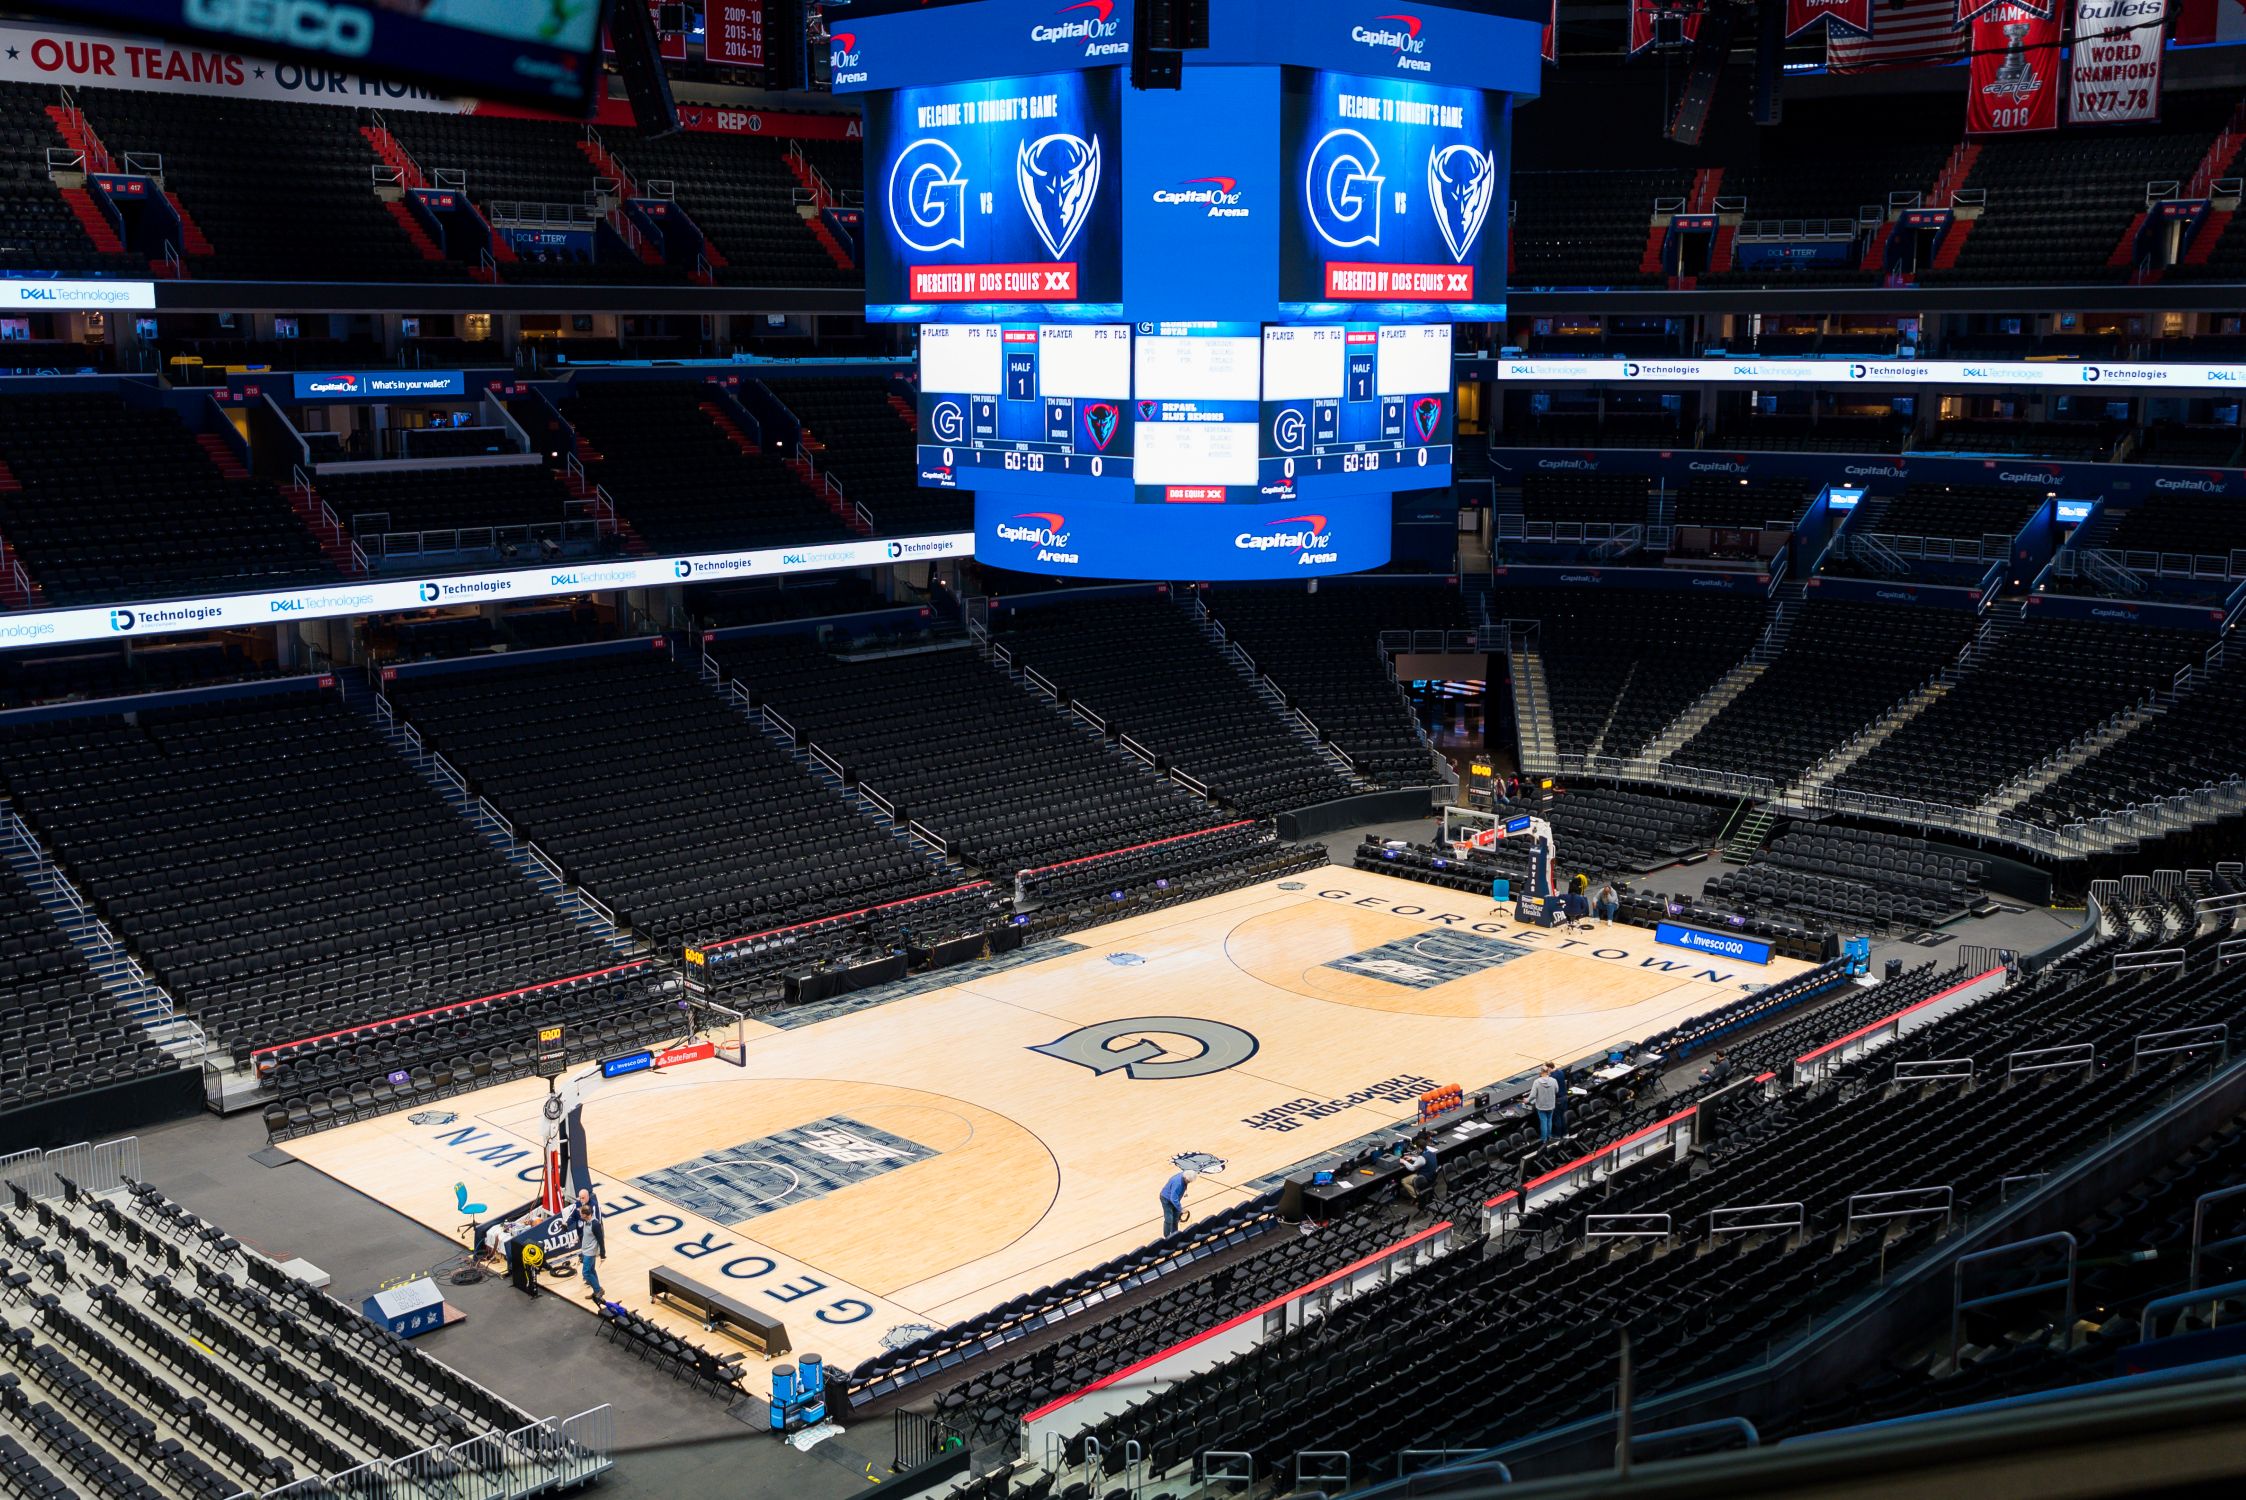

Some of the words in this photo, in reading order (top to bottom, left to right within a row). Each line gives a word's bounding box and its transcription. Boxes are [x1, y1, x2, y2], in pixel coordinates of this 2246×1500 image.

[724, 7, 762, 24] 2009-10
[2079, 1, 2162, 19] bullets
[725, 25, 762, 41] 2015-16
[2103, 27, 2132, 42] NBA
[725, 42, 762, 58] 2016-17
[1085, 42, 1129, 57] Arena
[2092, 45, 2141, 62] WORLD
[31, 39, 117, 76] OUR
[125, 46, 245, 87] TEAMS
[1397, 55, 1431, 72] Arena
[275, 62, 348, 94] OUR
[835, 72, 868, 84] Arena
[2075, 62, 2156, 82] CHAMPIONS
[2078, 90, 2148, 112] 1977-78
[918, 103, 961, 128] WELCOME
[964, 102, 975, 124] TO
[977, 97, 1027, 123] TONIGHT'S
[1030, 94, 1058, 119] GAME
[1338, 94, 1381, 120] WELCOME
[1383, 99, 1393, 121] TO
[1395, 101, 1439, 126] TONIGHT'S
[1440, 106, 1463, 129] GAME
[1992, 107, 2029, 128] 2018
[979, 192, 993, 215] VS
[1394, 192, 1407, 214] VS
[1208, 206, 1249, 217] Arena
[917, 272, 962, 293] PRESENTED
[964, 272, 975, 292] BY
[979, 272, 1002, 291] DOS
[1005, 272, 1040, 292] EQUIS
[1044, 272, 1071, 291] XX
[1332, 270, 1377, 291] PRESENTED
[1377, 272, 1388, 291] BY
[1392, 273, 1412, 291] DOS
[1414, 274, 1443, 292] EQUIS
[1446, 274, 1468, 292] XX
[20, 288, 57, 300] DELL
[57, 288, 130, 302] Technologies
[928, 329, 949, 337] PLAYER
[968, 329, 980, 337] PTS
[1048, 329, 1073, 338] PLAYER
[1094, 330, 1108, 339] PTS
[1114, 330, 1127, 339] FLS
[1273, 331, 1294, 340] PLAYER
[1314, 331, 1324, 340] PTS
[1011, 362, 1031, 372] HALF
[1352, 363, 1370, 373] HALF
[1642, 365, 1700, 375] Technologies
[1869, 366, 1929, 377] Technologies
[2103, 369, 2167, 381] Technologies
[371, 380, 398, 390] What's
[406, 381, 422, 391] your
[1018, 378, 1025, 395] 1
[1358, 379, 1365, 396] 1
[982, 405, 990, 417] 0
[1054, 408, 1062, 421] 0
[1324, 409, 1332, 422] 0
[1389, 405, 1396, 418] 0
[943, 447, 954, 467] 0
[976, 451, 981, 463] 1
[1004, 452, 1044, 471] 60:00
[1064, 457, 1069, 469] 1
[1317, 458, 1321, 470] 1
[1343, 452, 1379, 472] 60:00
[1396, 451, 1400, 463] 1
[1417, 447, 1428, 467] 0
[1091, 456, 1103, 477] 0
[1284, 458, 1295, 478] 0
[903, 540, 953, 552] Technologies
[783, 554, 807, 565] DELL
[1037, 549, 1079, 564] Arena
[1298, 550, 1337, 565] Arena
[693, 558, 752, 572] Technologies
[551, 574, 579, 585] DELL
[579, 569, 637, 584] Technologies
[442, 579, 511, 596] Technologies
[271, 599, 304, 612] DELL
[304, 593, 374, 610] Technologies
[138, 606, 222, 624] Technologies
[655, 640, 664, 648] 111
[321, 679, 334, 687] 112
[384, 671, 394, 680] 111
[1523, 908, 1541, 917] Health
[1318, 889, 1735, 983] GEORGETOWN
[1693, 934, 1725, 950] Invesco
[1725, 941, 1744, 954] QQQ
[685, 948, 705, 966] 60:00
[540, 1028, 561, 1041] 60:00
[1300, 1074, 1424, 1120] THOMPSON
[1380, 1079, 1442, 1104] JOHN
[1241, 1098, 1321, 1129] COURT
[1260, 1117, 1304, 1133] JR.
